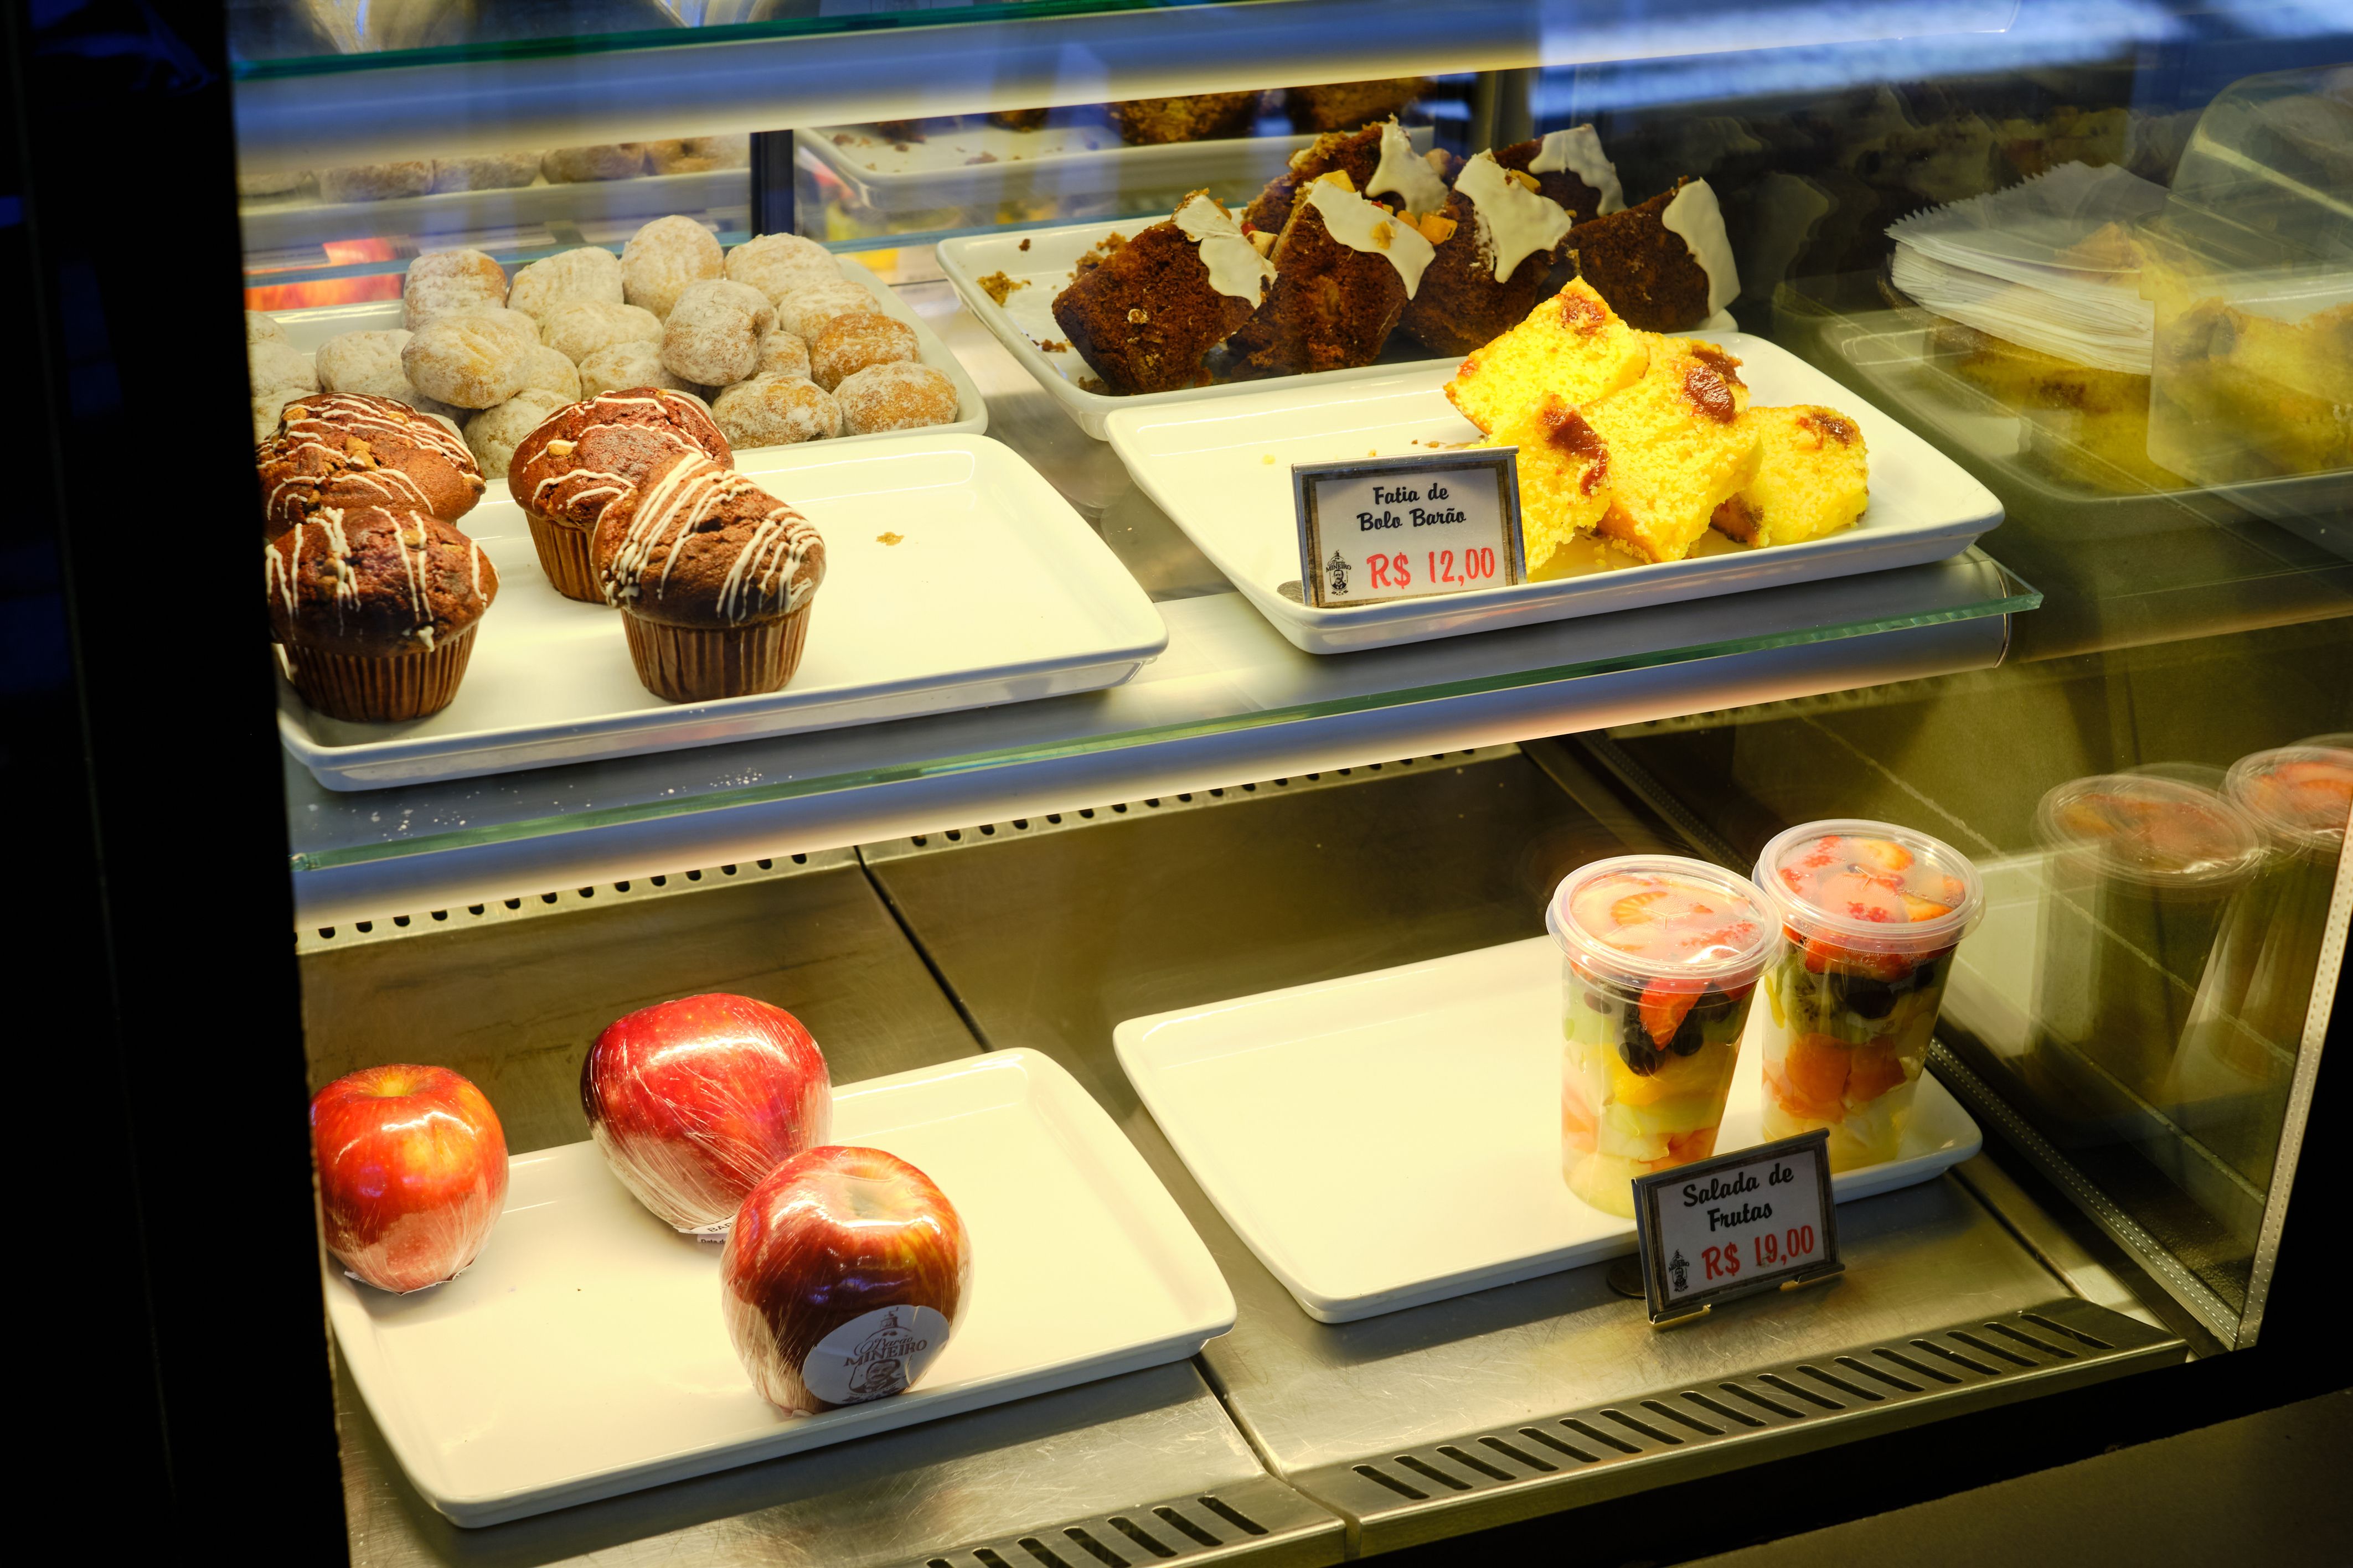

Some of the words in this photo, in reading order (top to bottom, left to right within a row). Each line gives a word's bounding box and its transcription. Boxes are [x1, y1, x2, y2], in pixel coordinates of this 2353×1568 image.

[1373, 487, 1420, 505] Fatia
[1428, 483, 1449, 500] de
[1356, 511, 1402, 531] Bolo
[1409, 508, 1467, 527] Barão
[1325, 563, 1351, 573] MINEIRO
[1366, 552, 1411, 589] R$
[1428, 547, 1495, 587] 12,00
[1683, 1171, 1760, 1207] Salada
[1768, 1163, 1794, 1185] de
[1707, 1203, 1772, 1232] Frutas
[1701, 1241, 1741, 1280] R$
[1755, 1225, 1814, 1266] 19,00
[843, 1339, 927, 1367] MINEIRO
